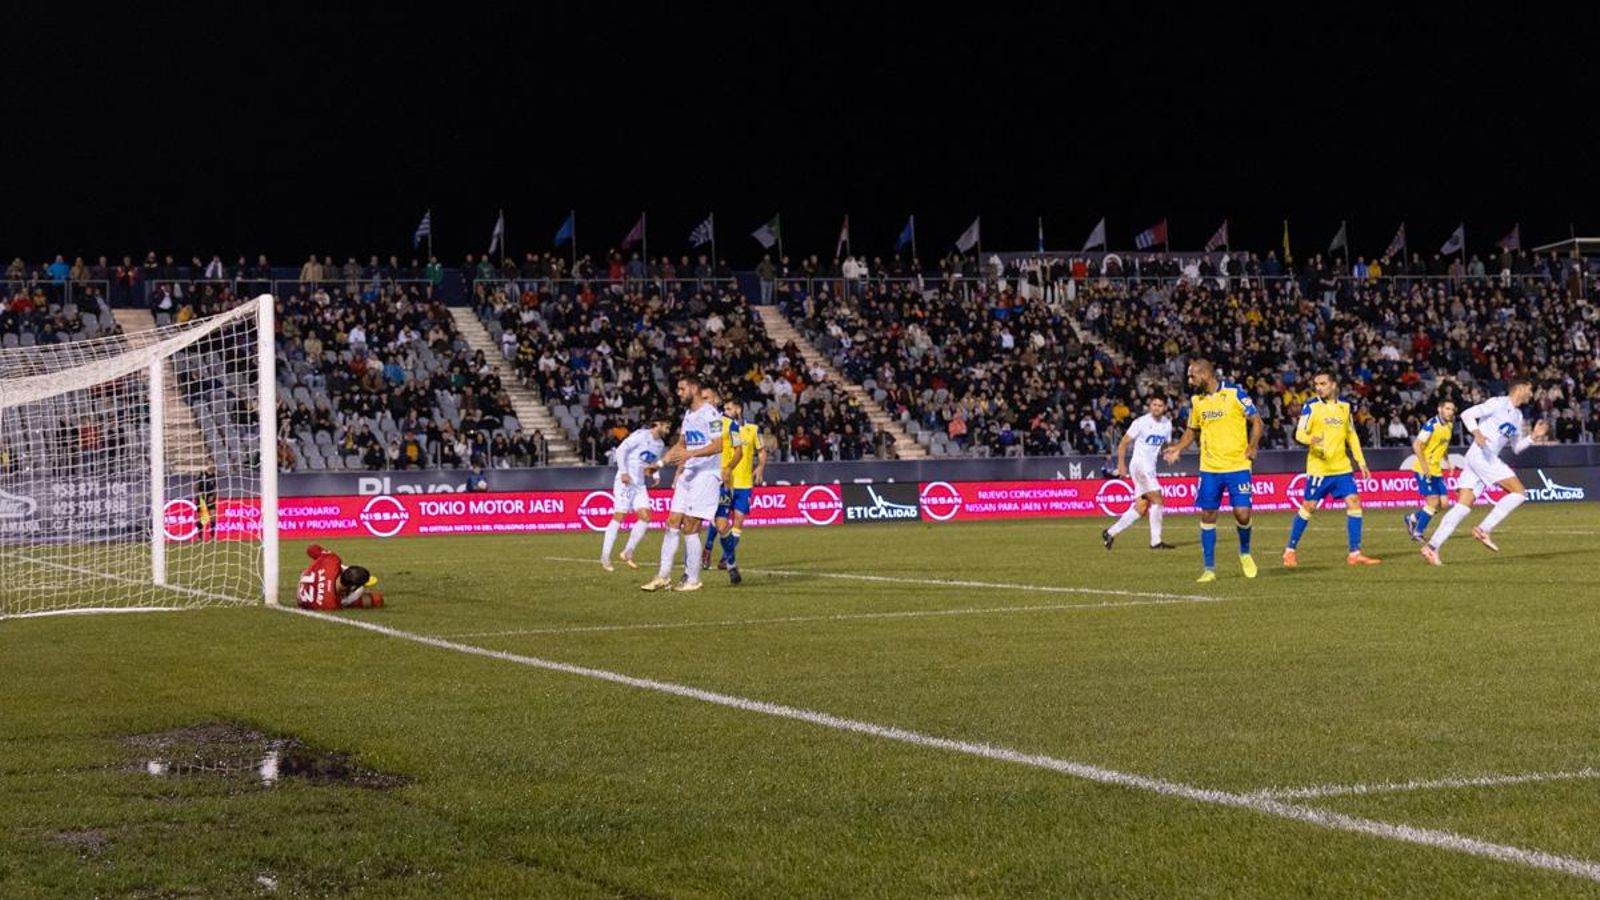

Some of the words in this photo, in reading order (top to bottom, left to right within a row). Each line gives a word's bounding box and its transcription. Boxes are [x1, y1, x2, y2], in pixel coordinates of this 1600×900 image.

[1251, 482, 1275, 495] AEN
[1356, 478, 1379, 492] ETO
[1381, 477, 1419, 491] MOTO
[978, 490, 1008, 500] NUEVO
[1009, 489, 1079, 499] CONCESIONARIO
[1160, 484, 1188, 498] KIO
[648, 498, 672, 512] RET
[750, 494, 786, 509] ADIZ
[798, 501, 843, 510] NISSAN
[920, 496, 962, 505] NISSAN
[277, 506, 341, 517] NCESIONARIO
[419, 501, 466, 516] TOKIO
[469, 500, 525, 515] MOTOR
[528, 499, 564, 514] JAEN
[577, 507, 615, 516] NISSA
[965, 503, 998, 513] NISSAN
[998, 502, 1020, 511] PARA
[1043, 502, 1048, 510] Y
[1050, 501, 1095, 511] PROVINCIA
[360, 512, 409, 521] NISSAN
[277, 521, 297, 530] AEN
[299, 571, 316, 603] 13
